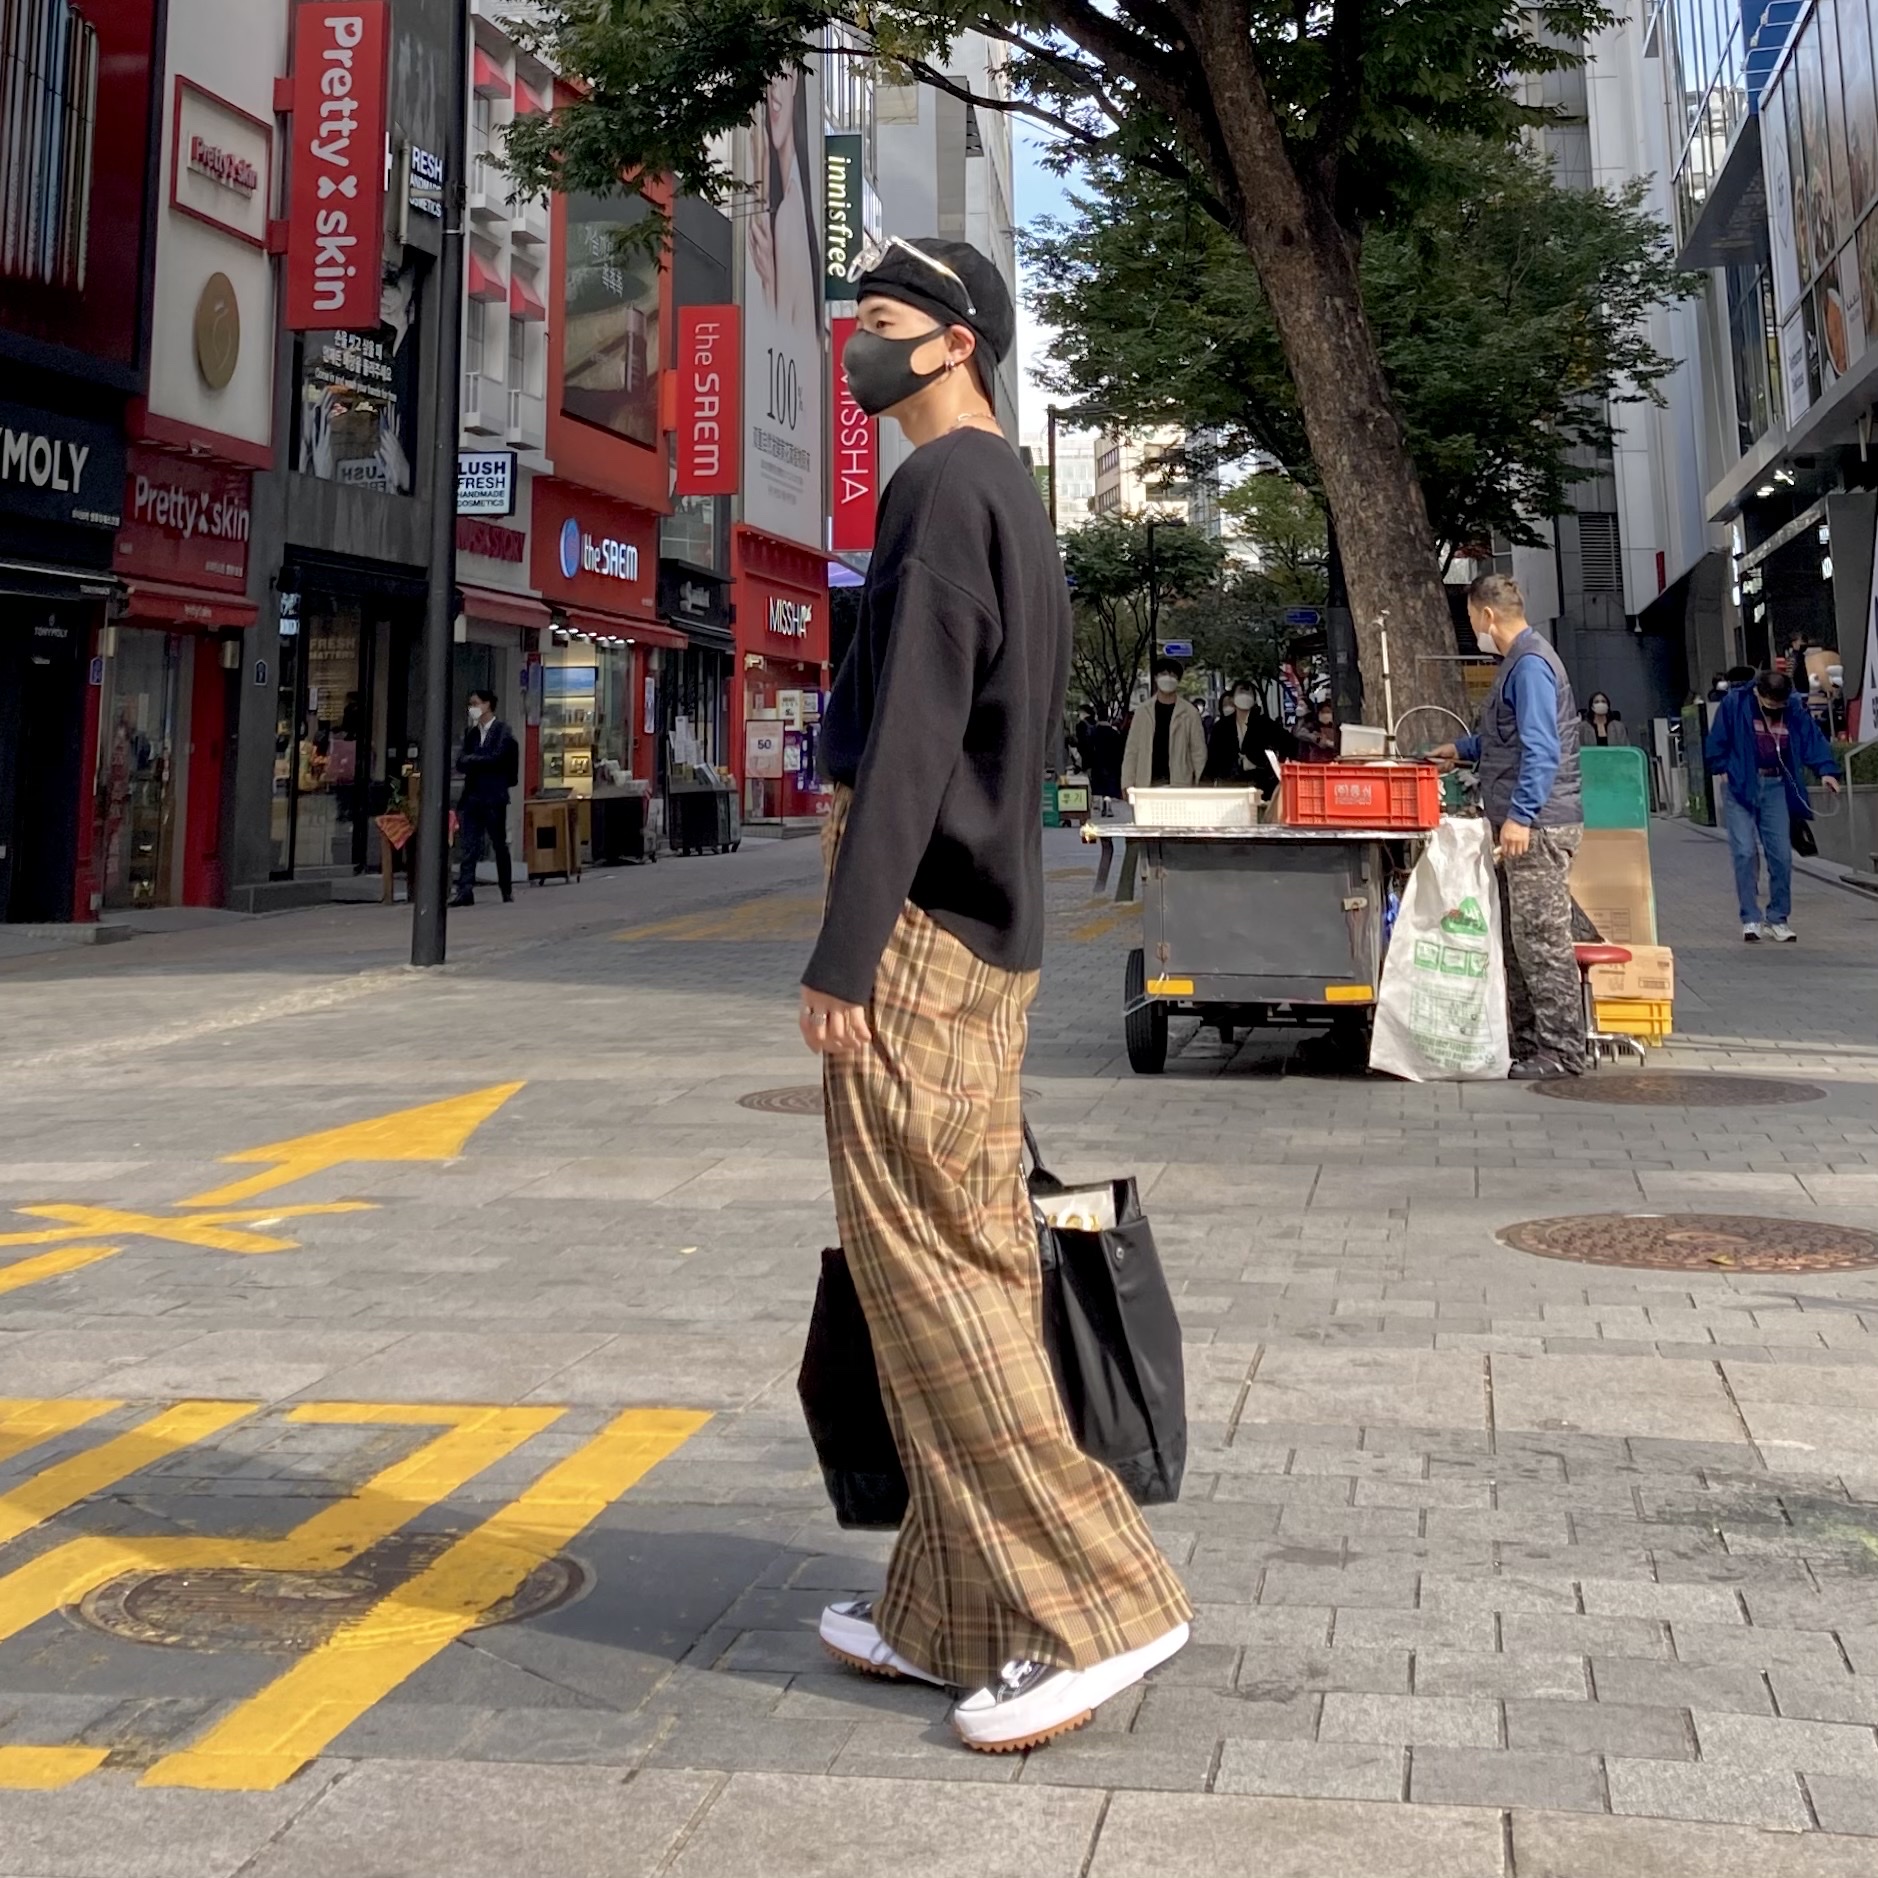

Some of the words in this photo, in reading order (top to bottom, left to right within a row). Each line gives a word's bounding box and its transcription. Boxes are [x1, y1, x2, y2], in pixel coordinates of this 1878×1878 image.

[310, 16, 363, 167] Pretty
[412, 145, 443, 182] RESH
[828, 155, 854, 278] innisfree
[313, 208, 358, 311] skin
[694, 322, 721, 366] the
[766, 348, 798, 431] 100
[840, 362, 869, 505] ISSHA
[0, 427, 90, 494] MOLY
[457, 461, 506, 475] LUSH
[457, 477, 506, 489] FRESH
[134, 475, 198, 539] Pretty
[211, 494, 250, 542] skin
[583, 533, 600, 573] the
[768, 596, 809, 639] MISSHA
[309, 638, 356, 650] FRESH
[757, 739, 772, 750] 50
